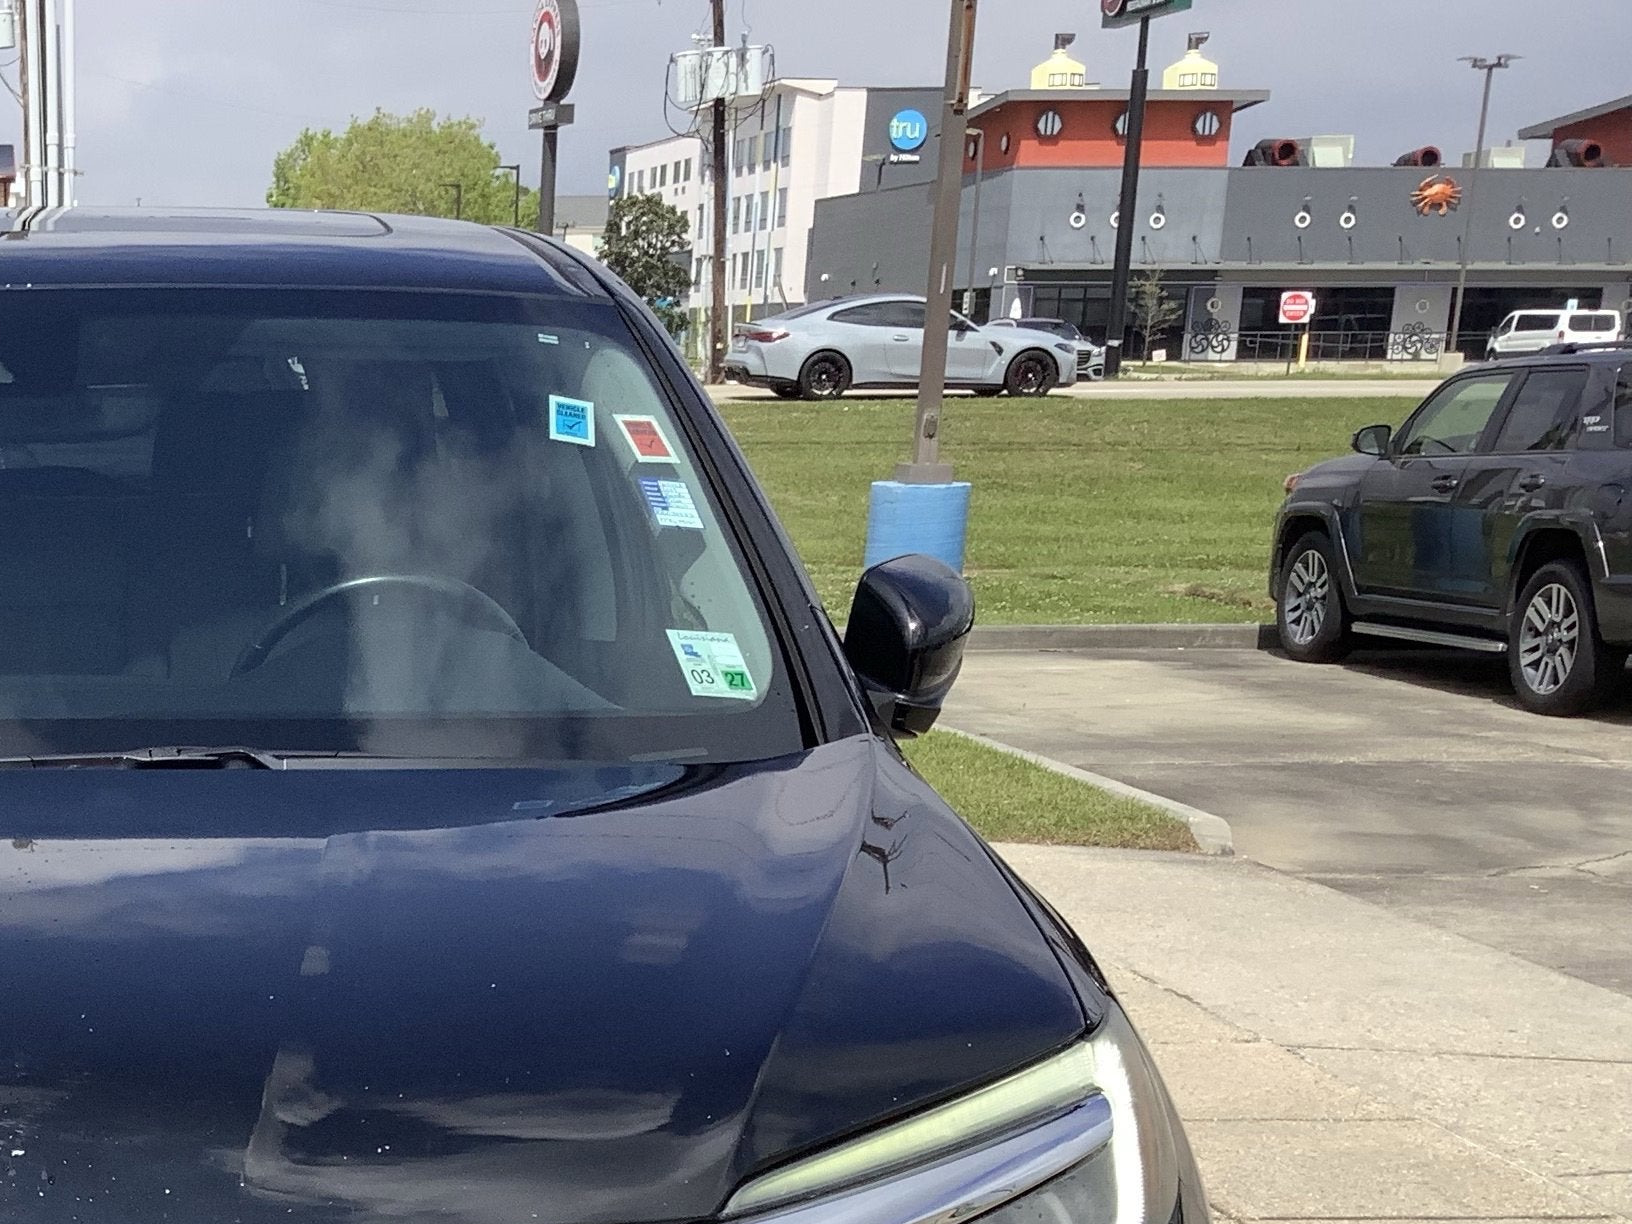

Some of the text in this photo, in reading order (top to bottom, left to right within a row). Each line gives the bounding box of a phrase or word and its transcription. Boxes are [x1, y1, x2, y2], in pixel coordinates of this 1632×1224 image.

[890, 117, 920, 139] tru
[677, 632, 730, 643] Louisiana
[691, 669, 745, 687] 03 27
